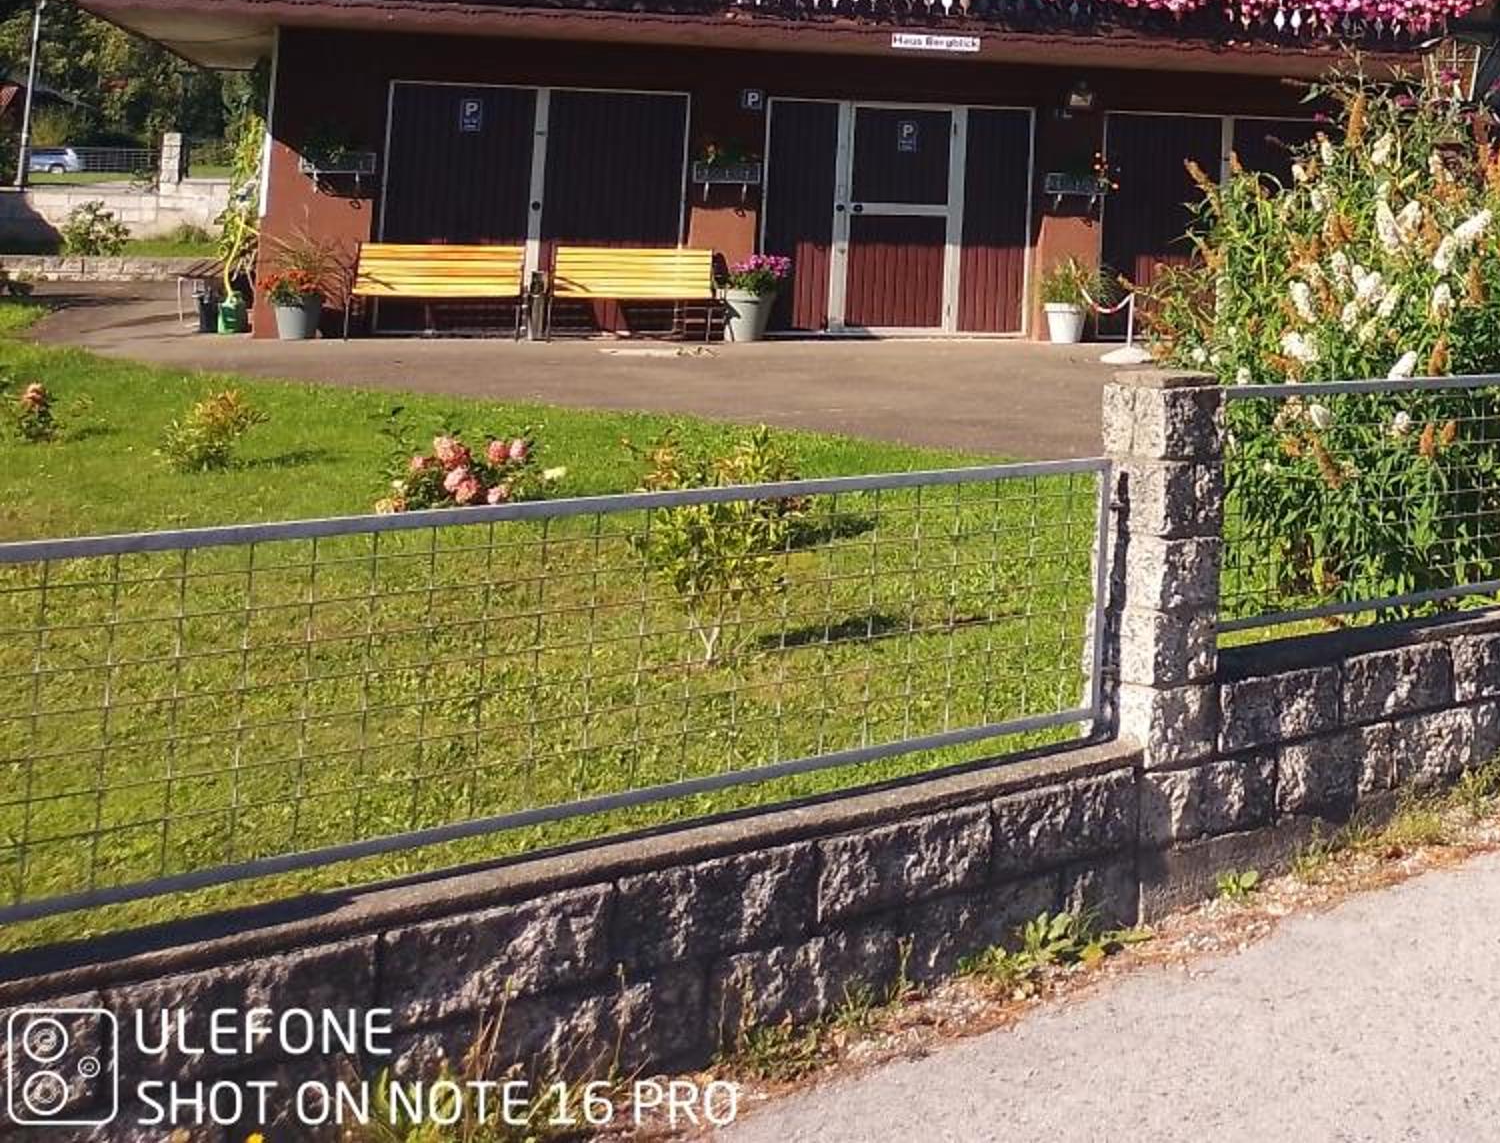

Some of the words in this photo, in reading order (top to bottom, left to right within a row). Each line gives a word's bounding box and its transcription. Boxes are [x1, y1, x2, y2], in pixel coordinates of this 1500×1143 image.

[893, 36, 922, 46] Haus
[925, 36, 977, 48] Bergblick
[747, 92, 759, 106] P
[466, 102, 479, 116] P
[903, 124, 914, 138] P
